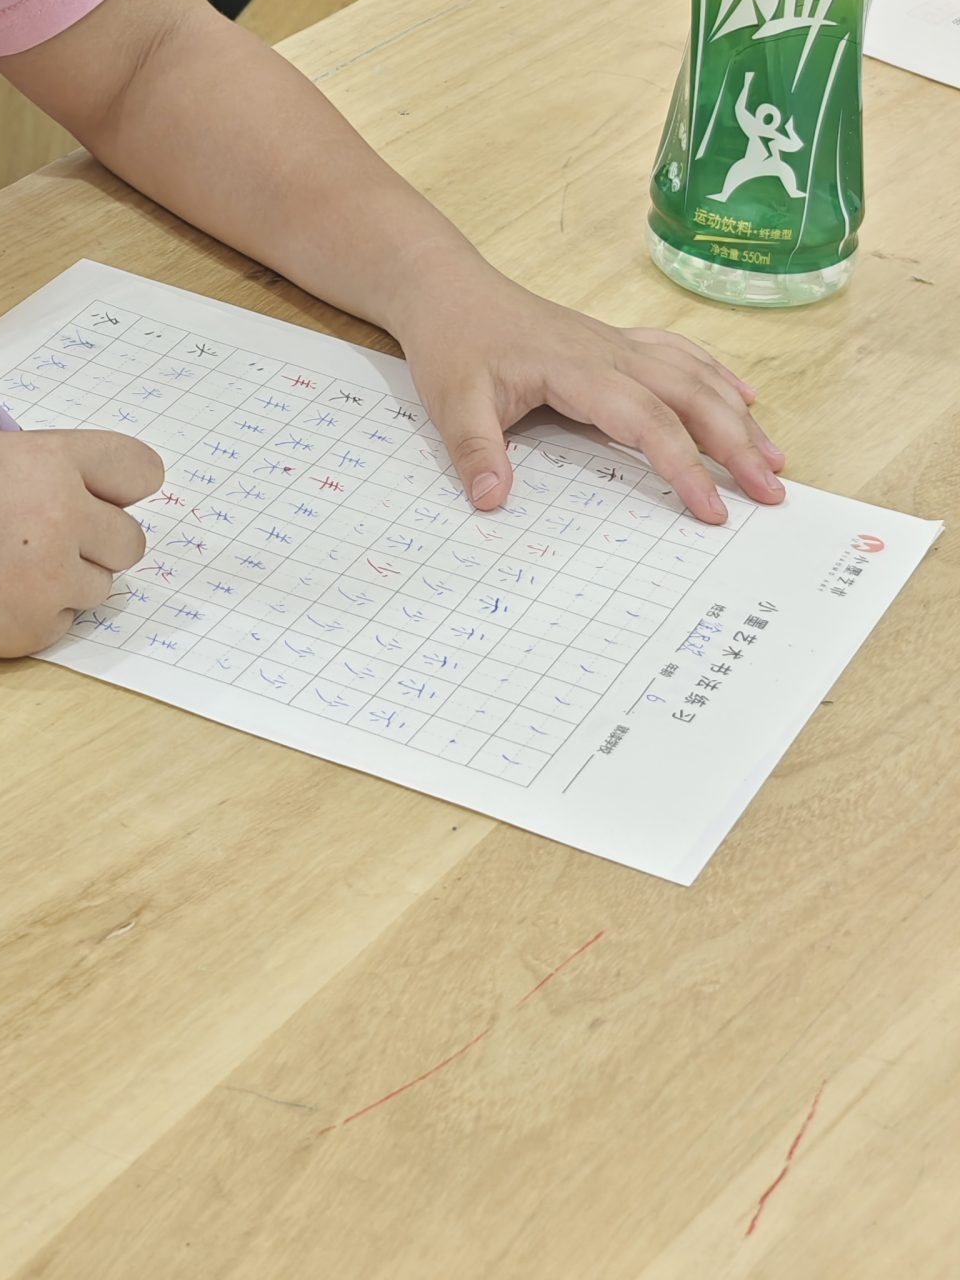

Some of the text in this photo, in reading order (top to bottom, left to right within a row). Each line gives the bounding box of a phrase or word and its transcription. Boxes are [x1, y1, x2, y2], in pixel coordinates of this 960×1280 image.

[710, 243, 771, 265] 净含量 550ml
[705, 602, 727, 619] 姓名
[671, 601, 779, 724] 小墨艺术书法练习
